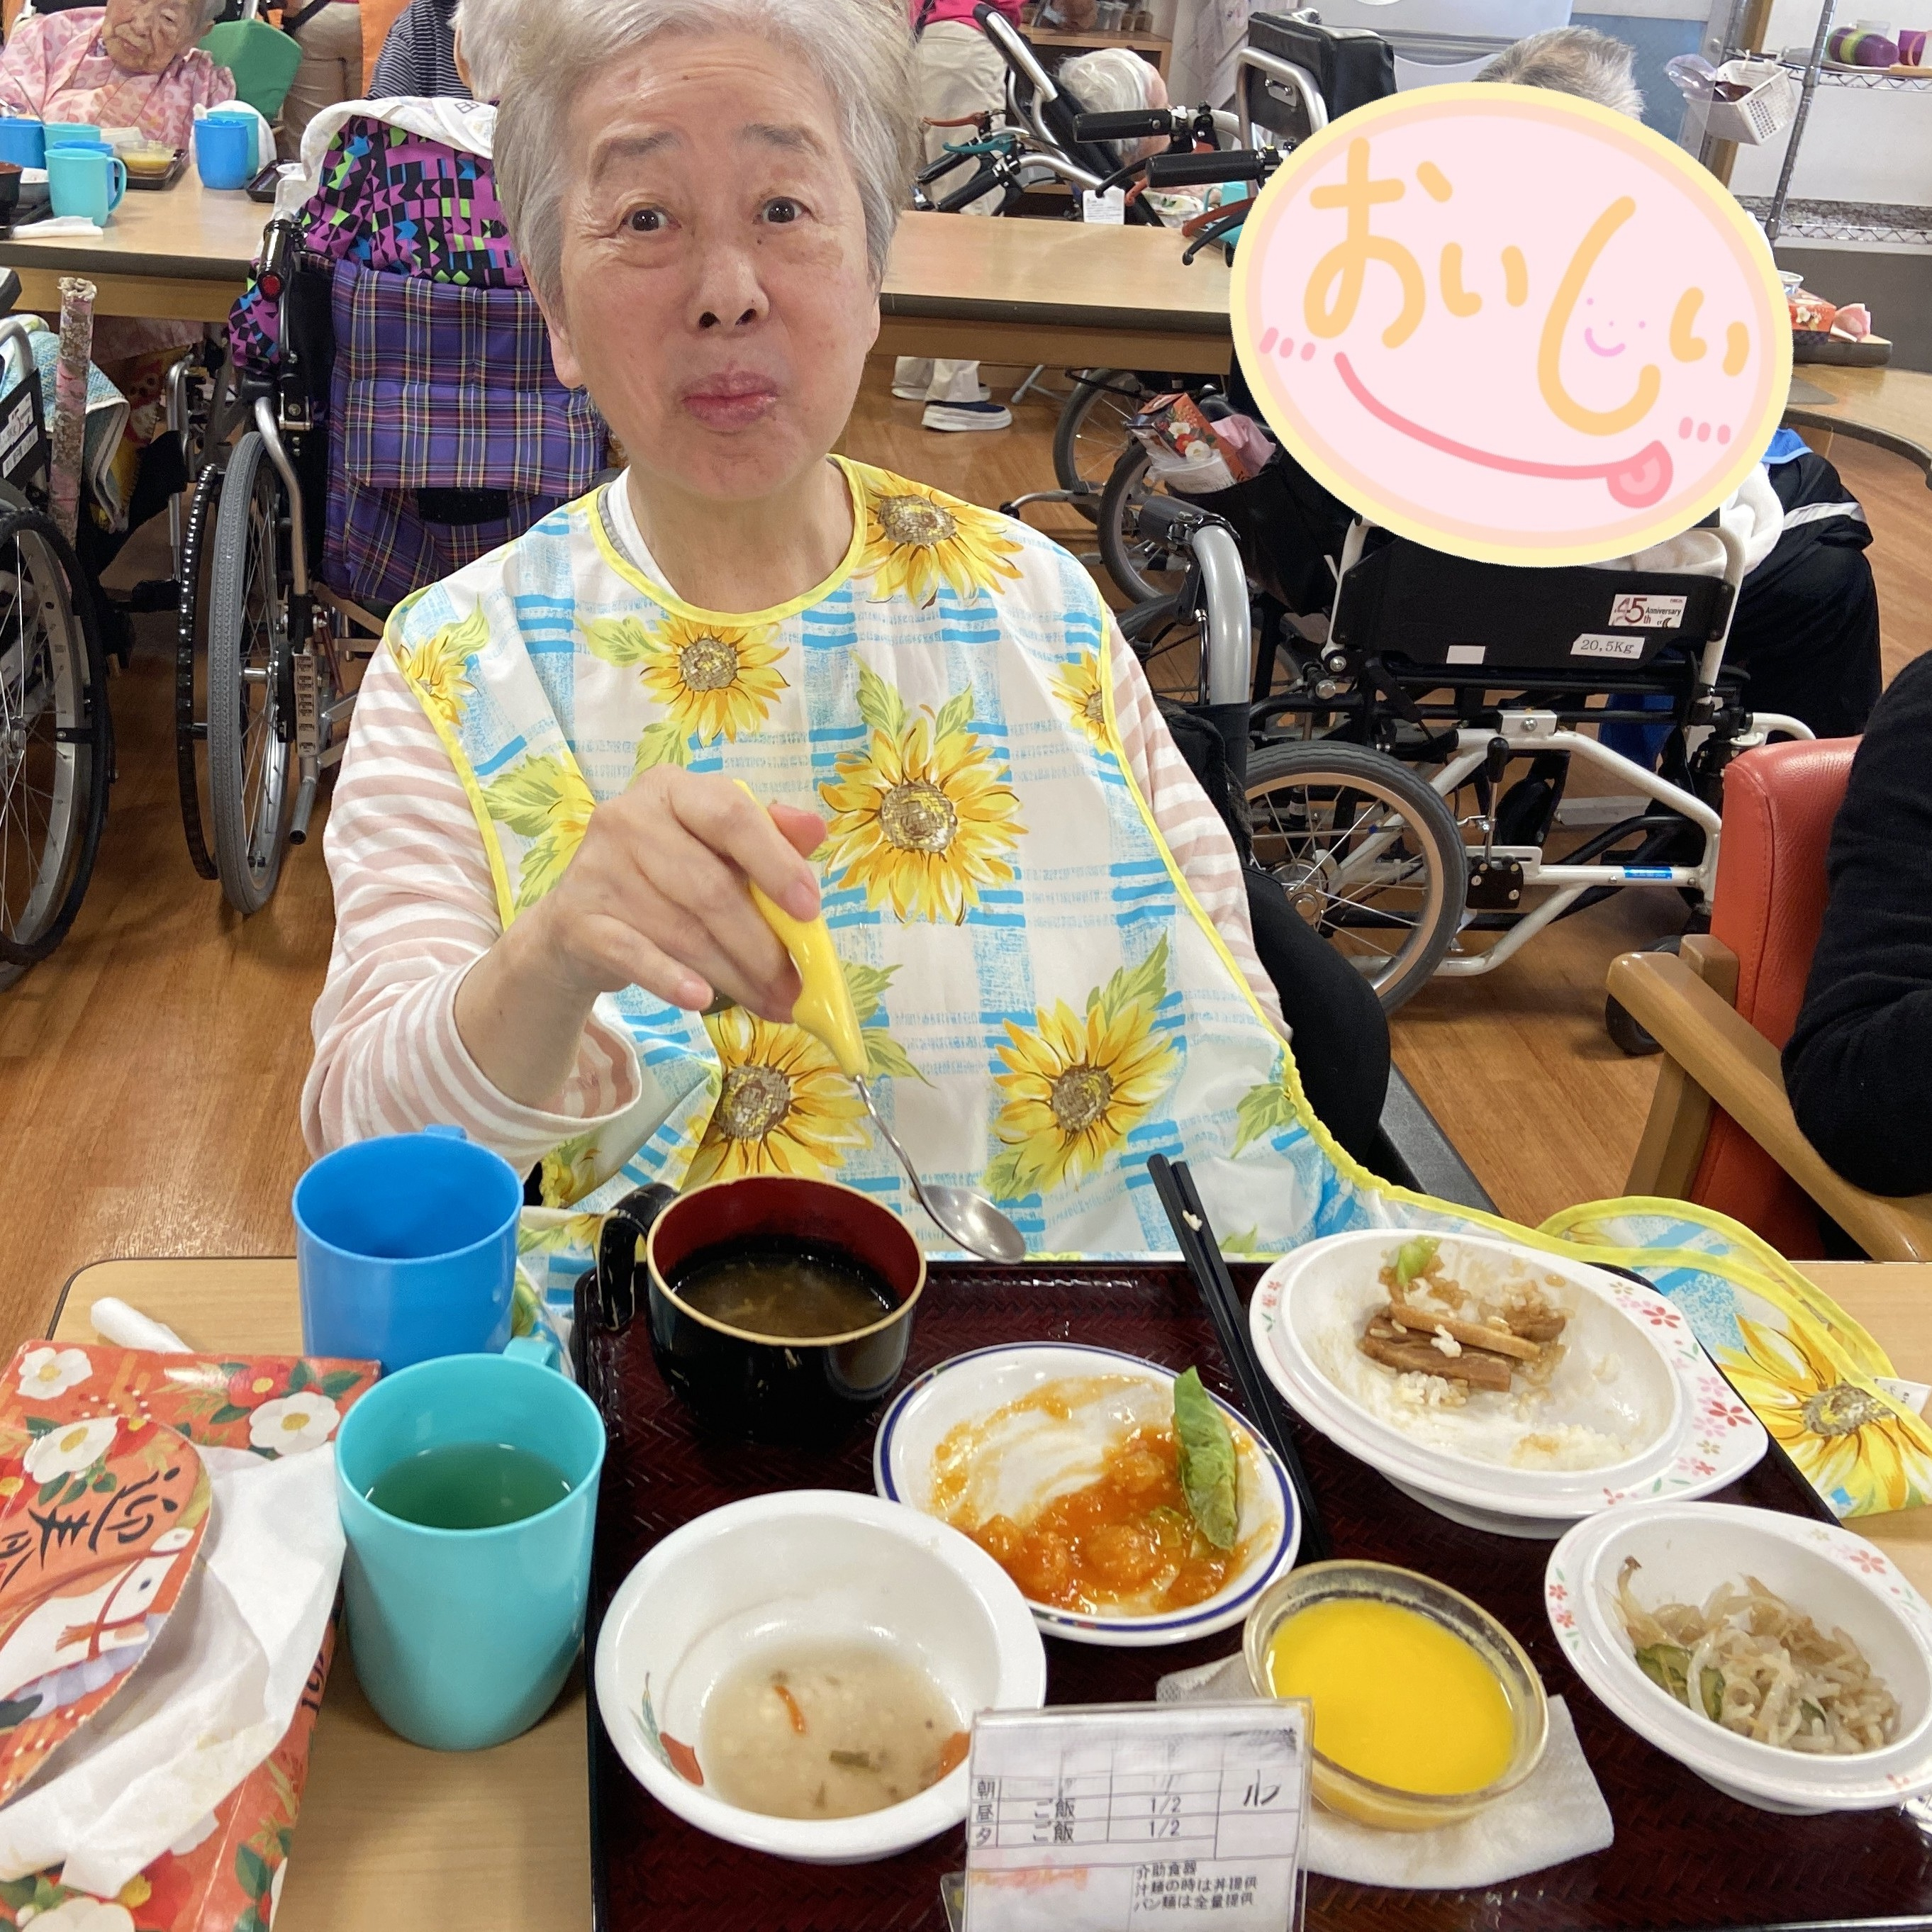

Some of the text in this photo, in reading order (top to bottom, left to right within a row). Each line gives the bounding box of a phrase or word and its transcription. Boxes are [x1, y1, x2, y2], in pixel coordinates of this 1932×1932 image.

[1614, 598, 1648, 623] 45
[1646, 607, 1681, 616] Anniversary
[0, 1466, 181, 1592] 迎春
[978, 1778, 995, 1799] 朝
[977, 1796, 1181, 1822] 昼 ご飯 1/2
[976, 1819, 1180, 1846] 夕 ご飯 1/2
